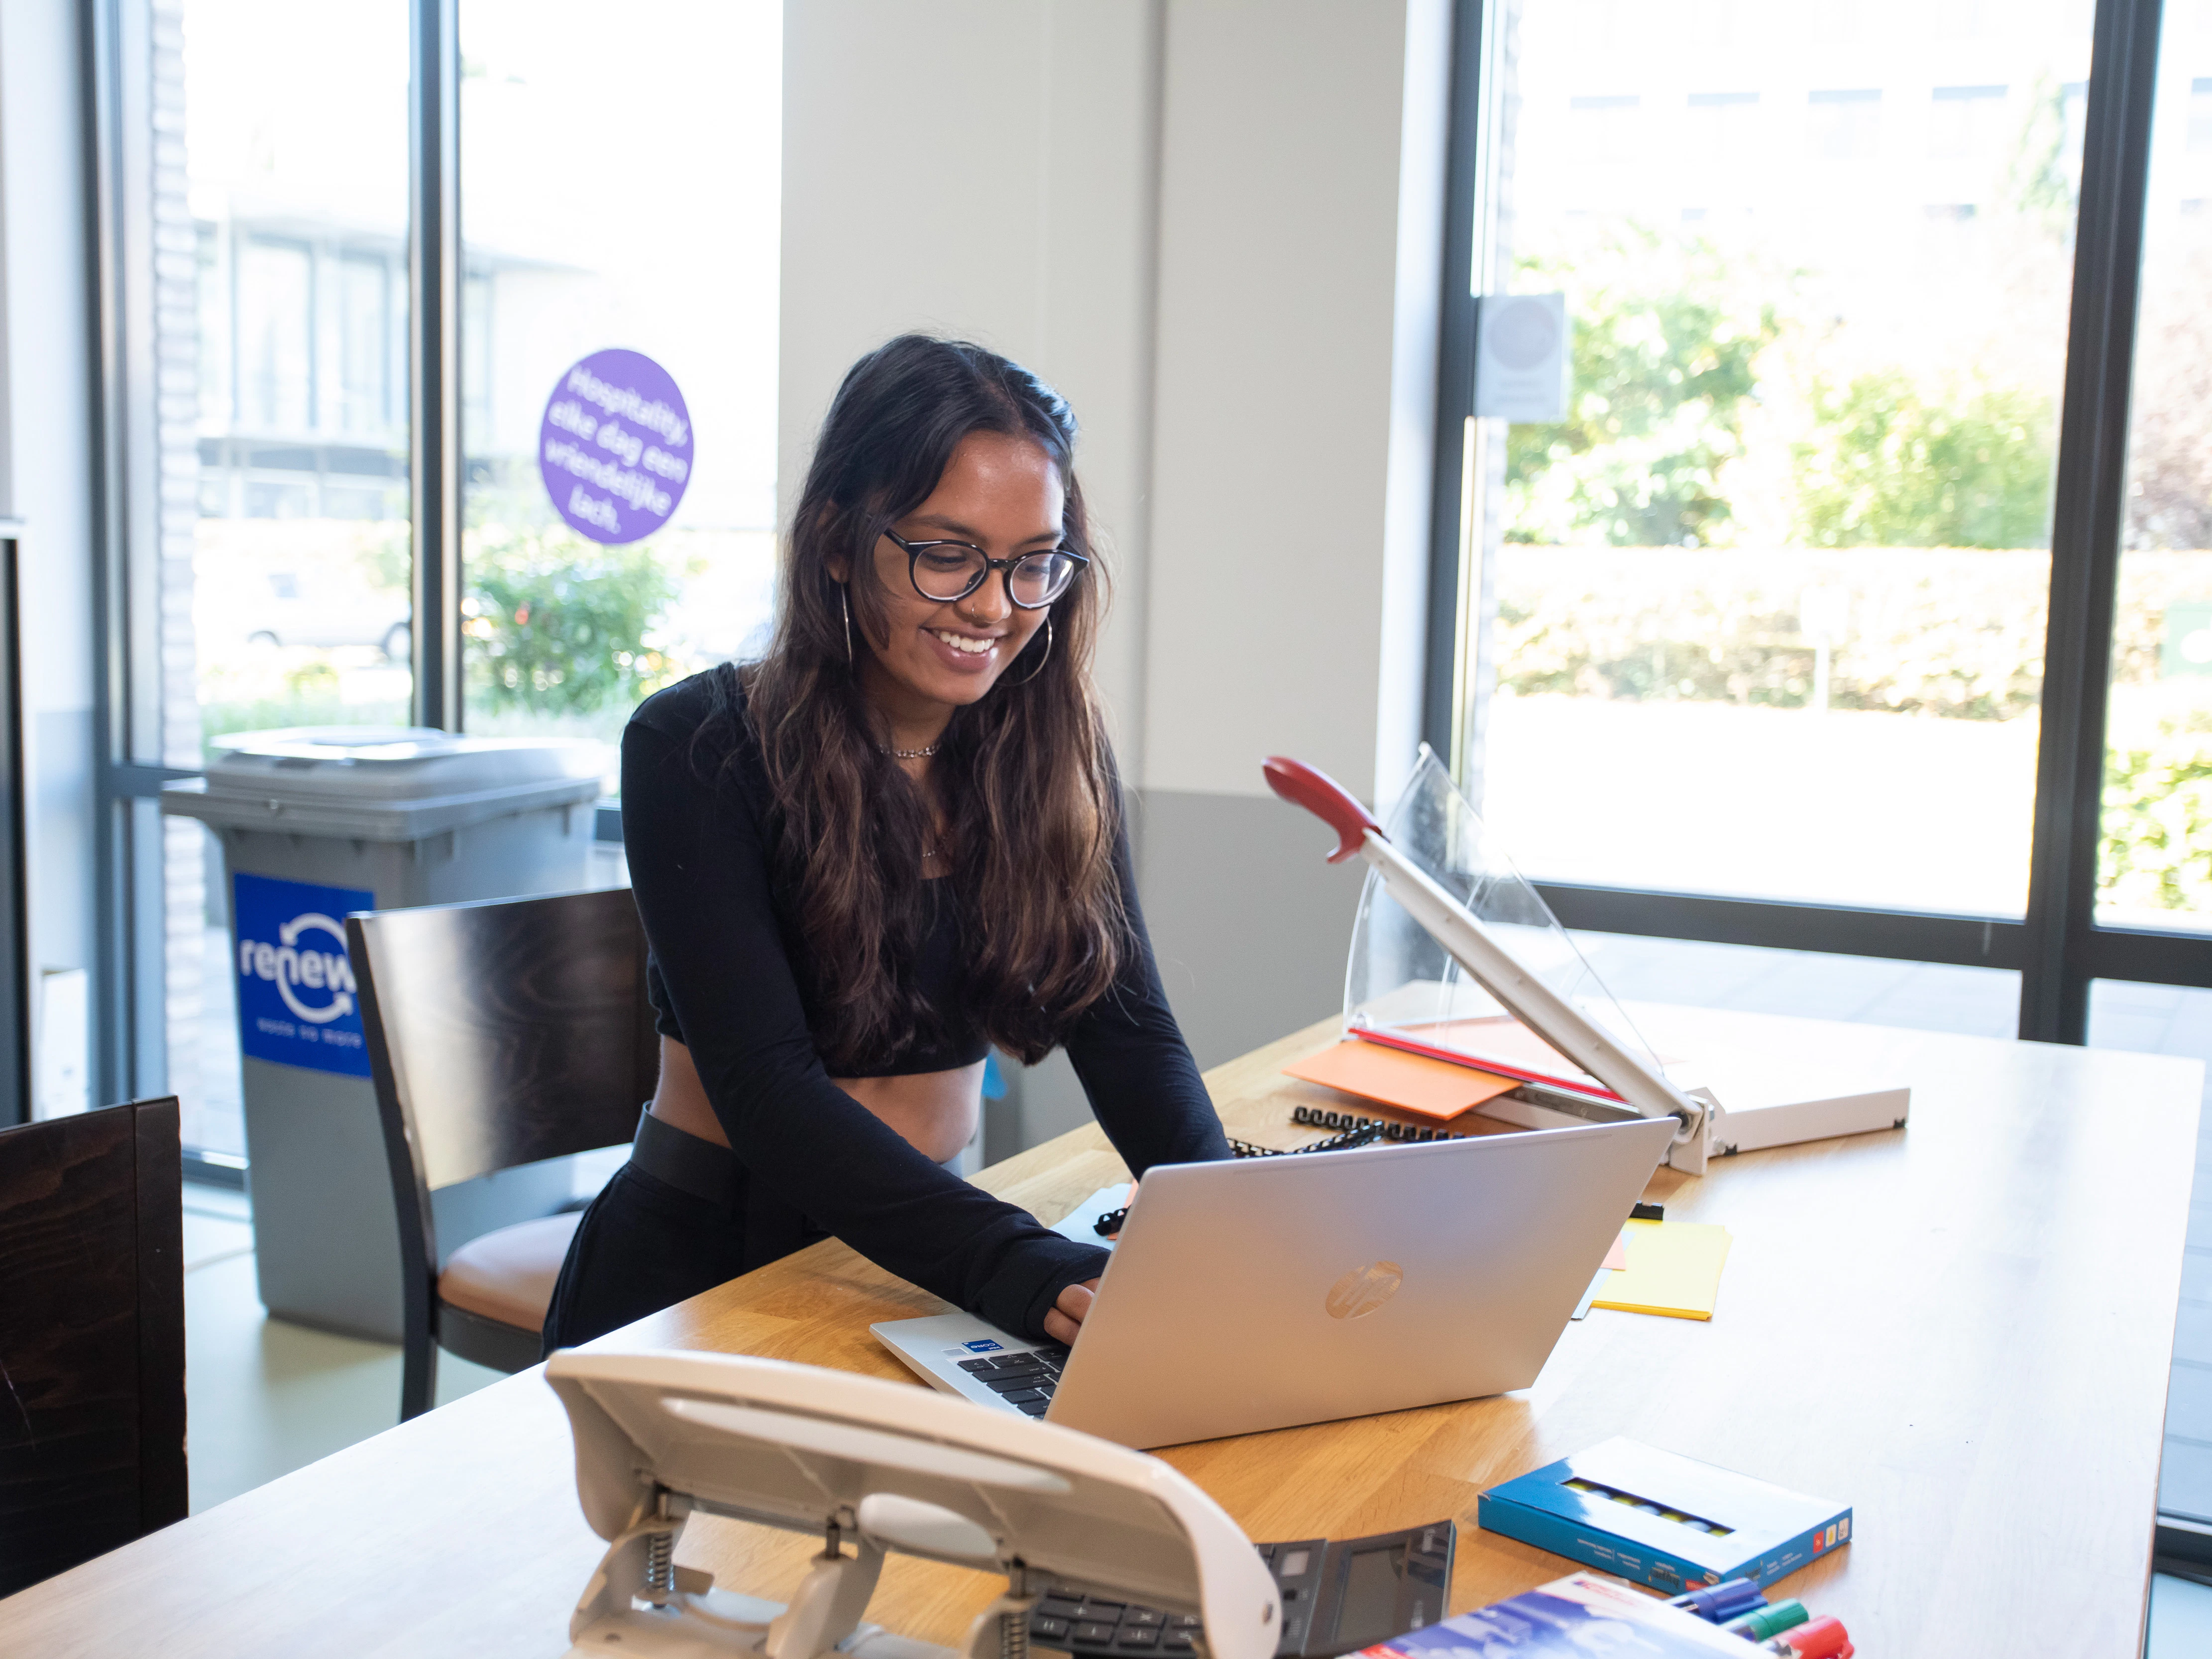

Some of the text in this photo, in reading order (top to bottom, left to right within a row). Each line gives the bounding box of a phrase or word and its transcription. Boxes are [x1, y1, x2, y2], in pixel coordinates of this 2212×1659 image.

[549, 401, 688, 483] elke dag een
